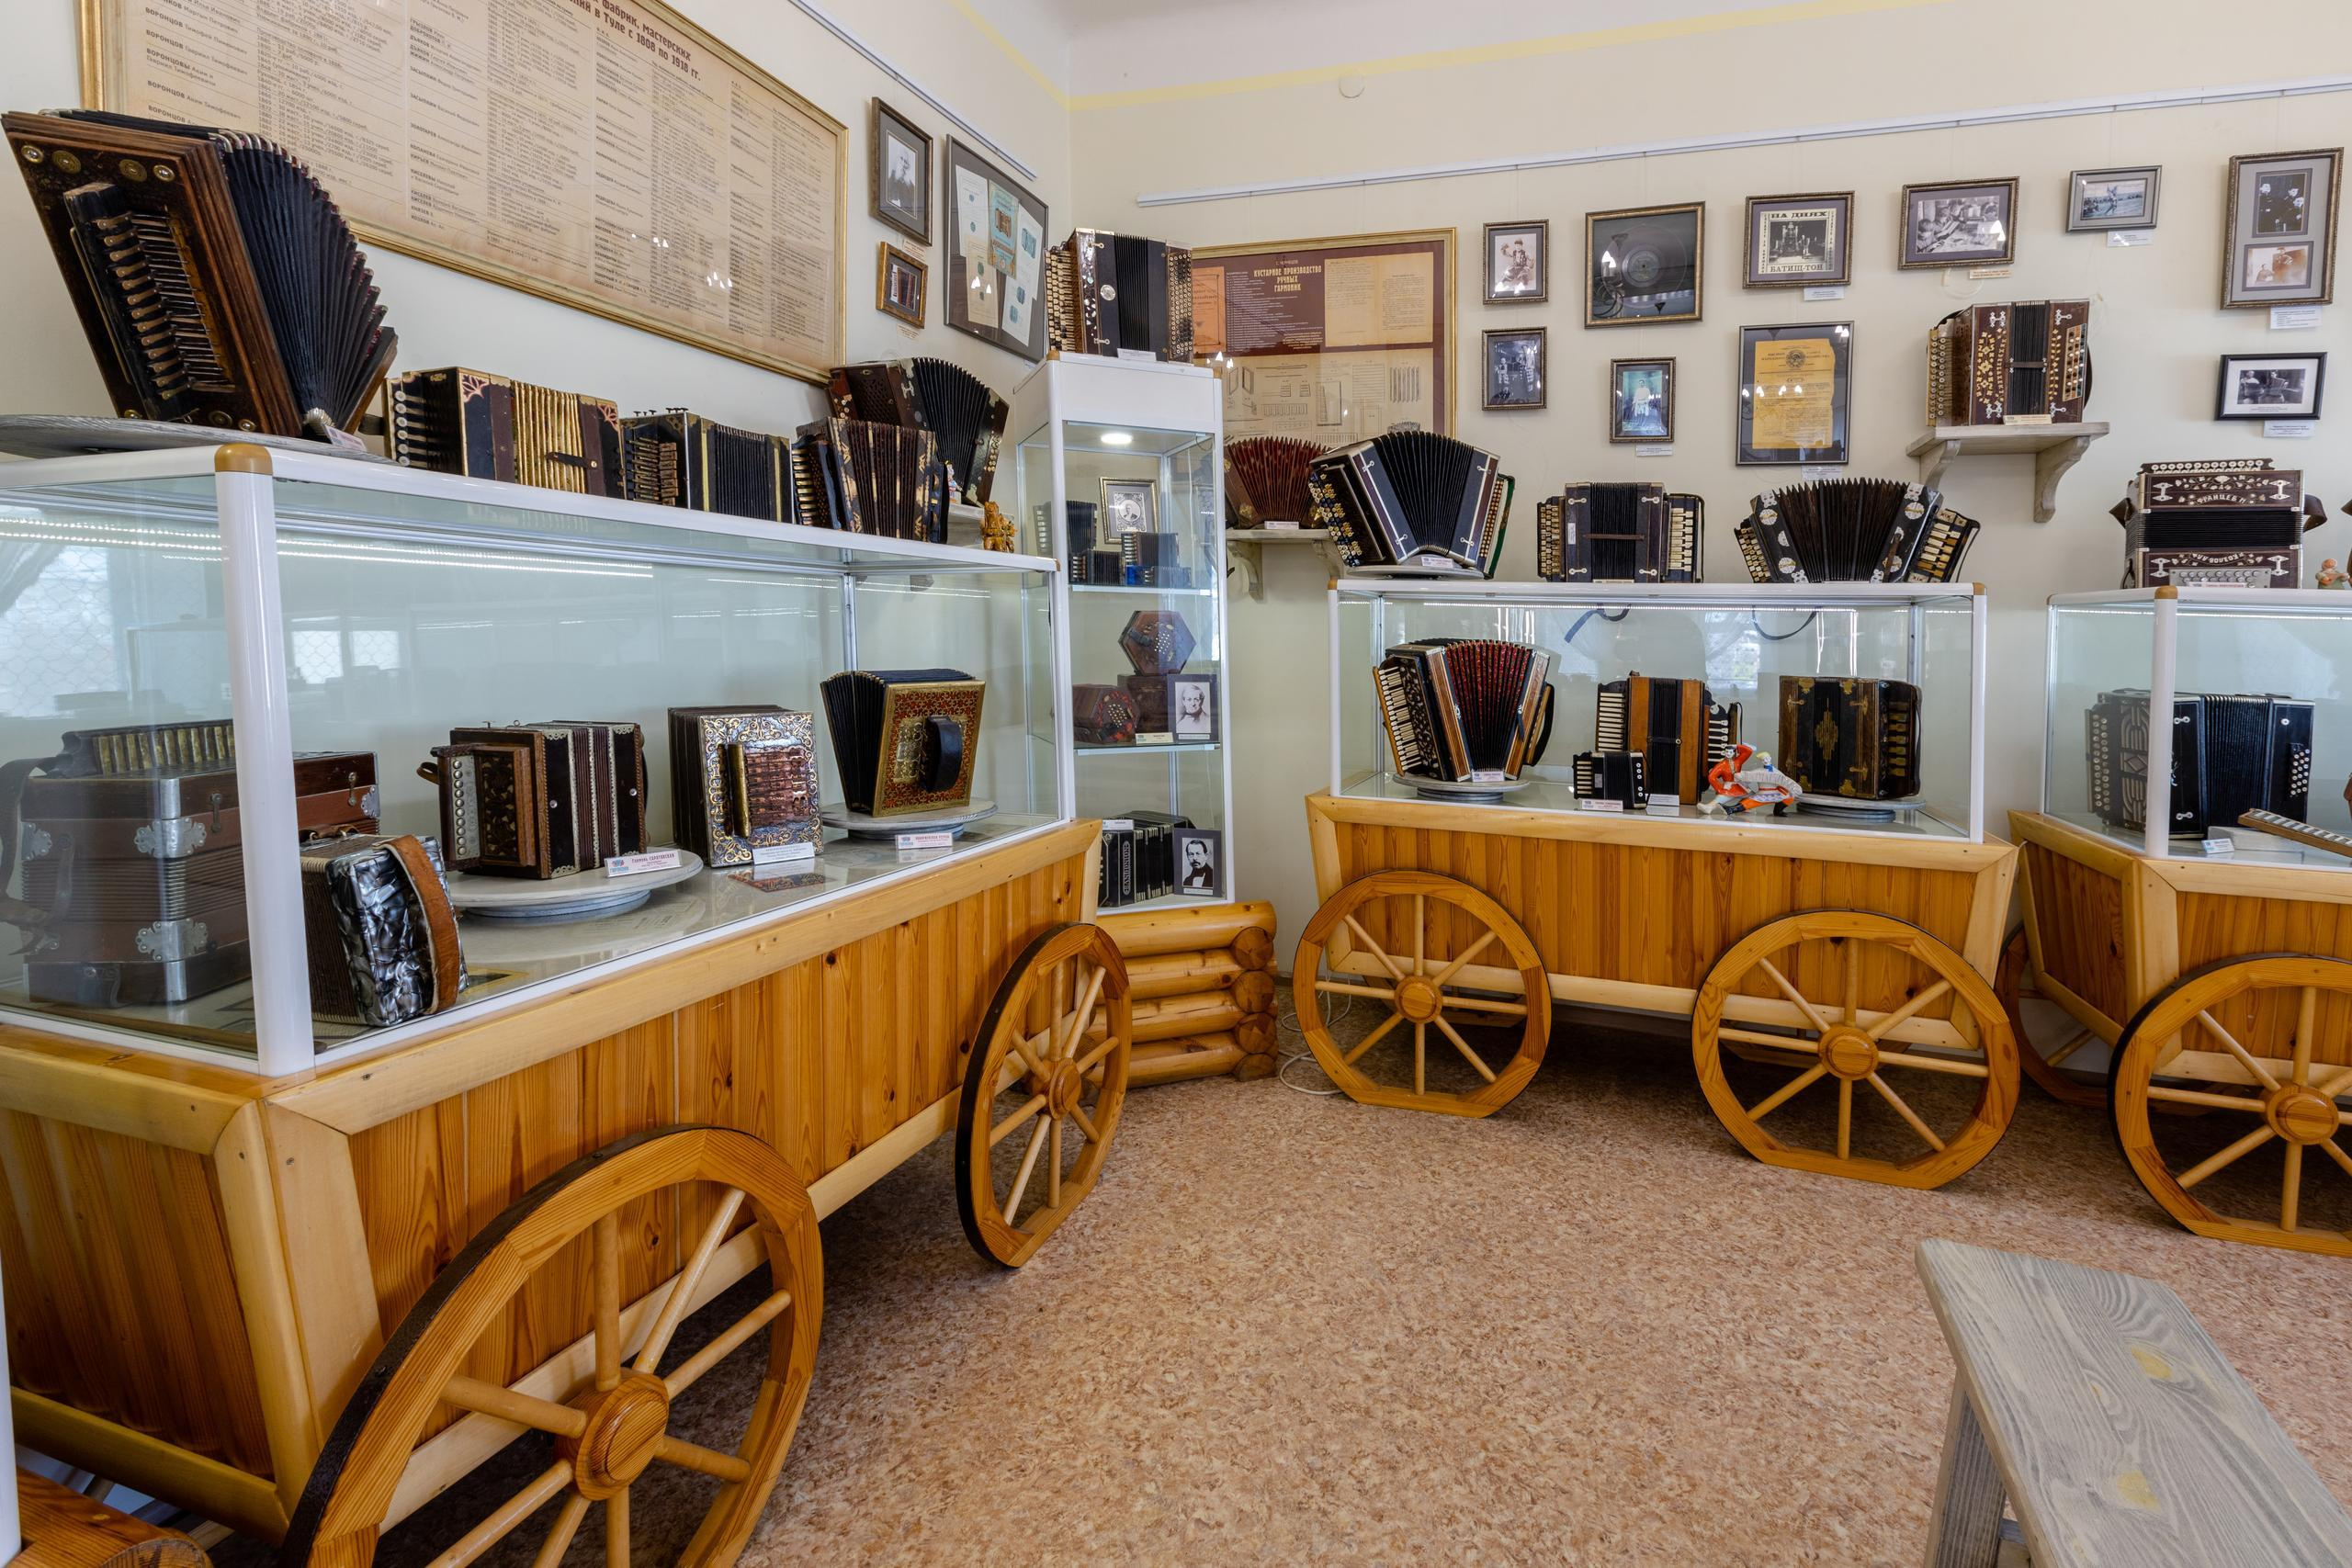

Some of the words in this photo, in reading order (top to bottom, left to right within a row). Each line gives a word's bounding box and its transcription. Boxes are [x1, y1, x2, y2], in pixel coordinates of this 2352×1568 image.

[145, 6, 183, 28] ВОРОНЦОВ
[146, 29, 183, 50] ВОРОНЦОВ
[604, 12, 625, 33] Туле
[628, 28, 633, 39] с
[637, 32, 656, 51] 1808
[659, 48, 669, 61] по
[672, 55, 688, 73] 1918
[147, 48, 189, 71] ВОРОНЦОВЫ
[147, 79, 185, 99] ВОРОНЦОВ
[148, 105, 185, 124] ВОРОНЦОВ
[1253, 268, 1282, 277] КУСТАРНОЕ
[1283, 265, 1322, 275] ПРОИЗВОДСТВО
[1277, 276, 1298, 284] РУЧНЫХ
[1274, 284, 1301, 292] ГАРМОНИК
